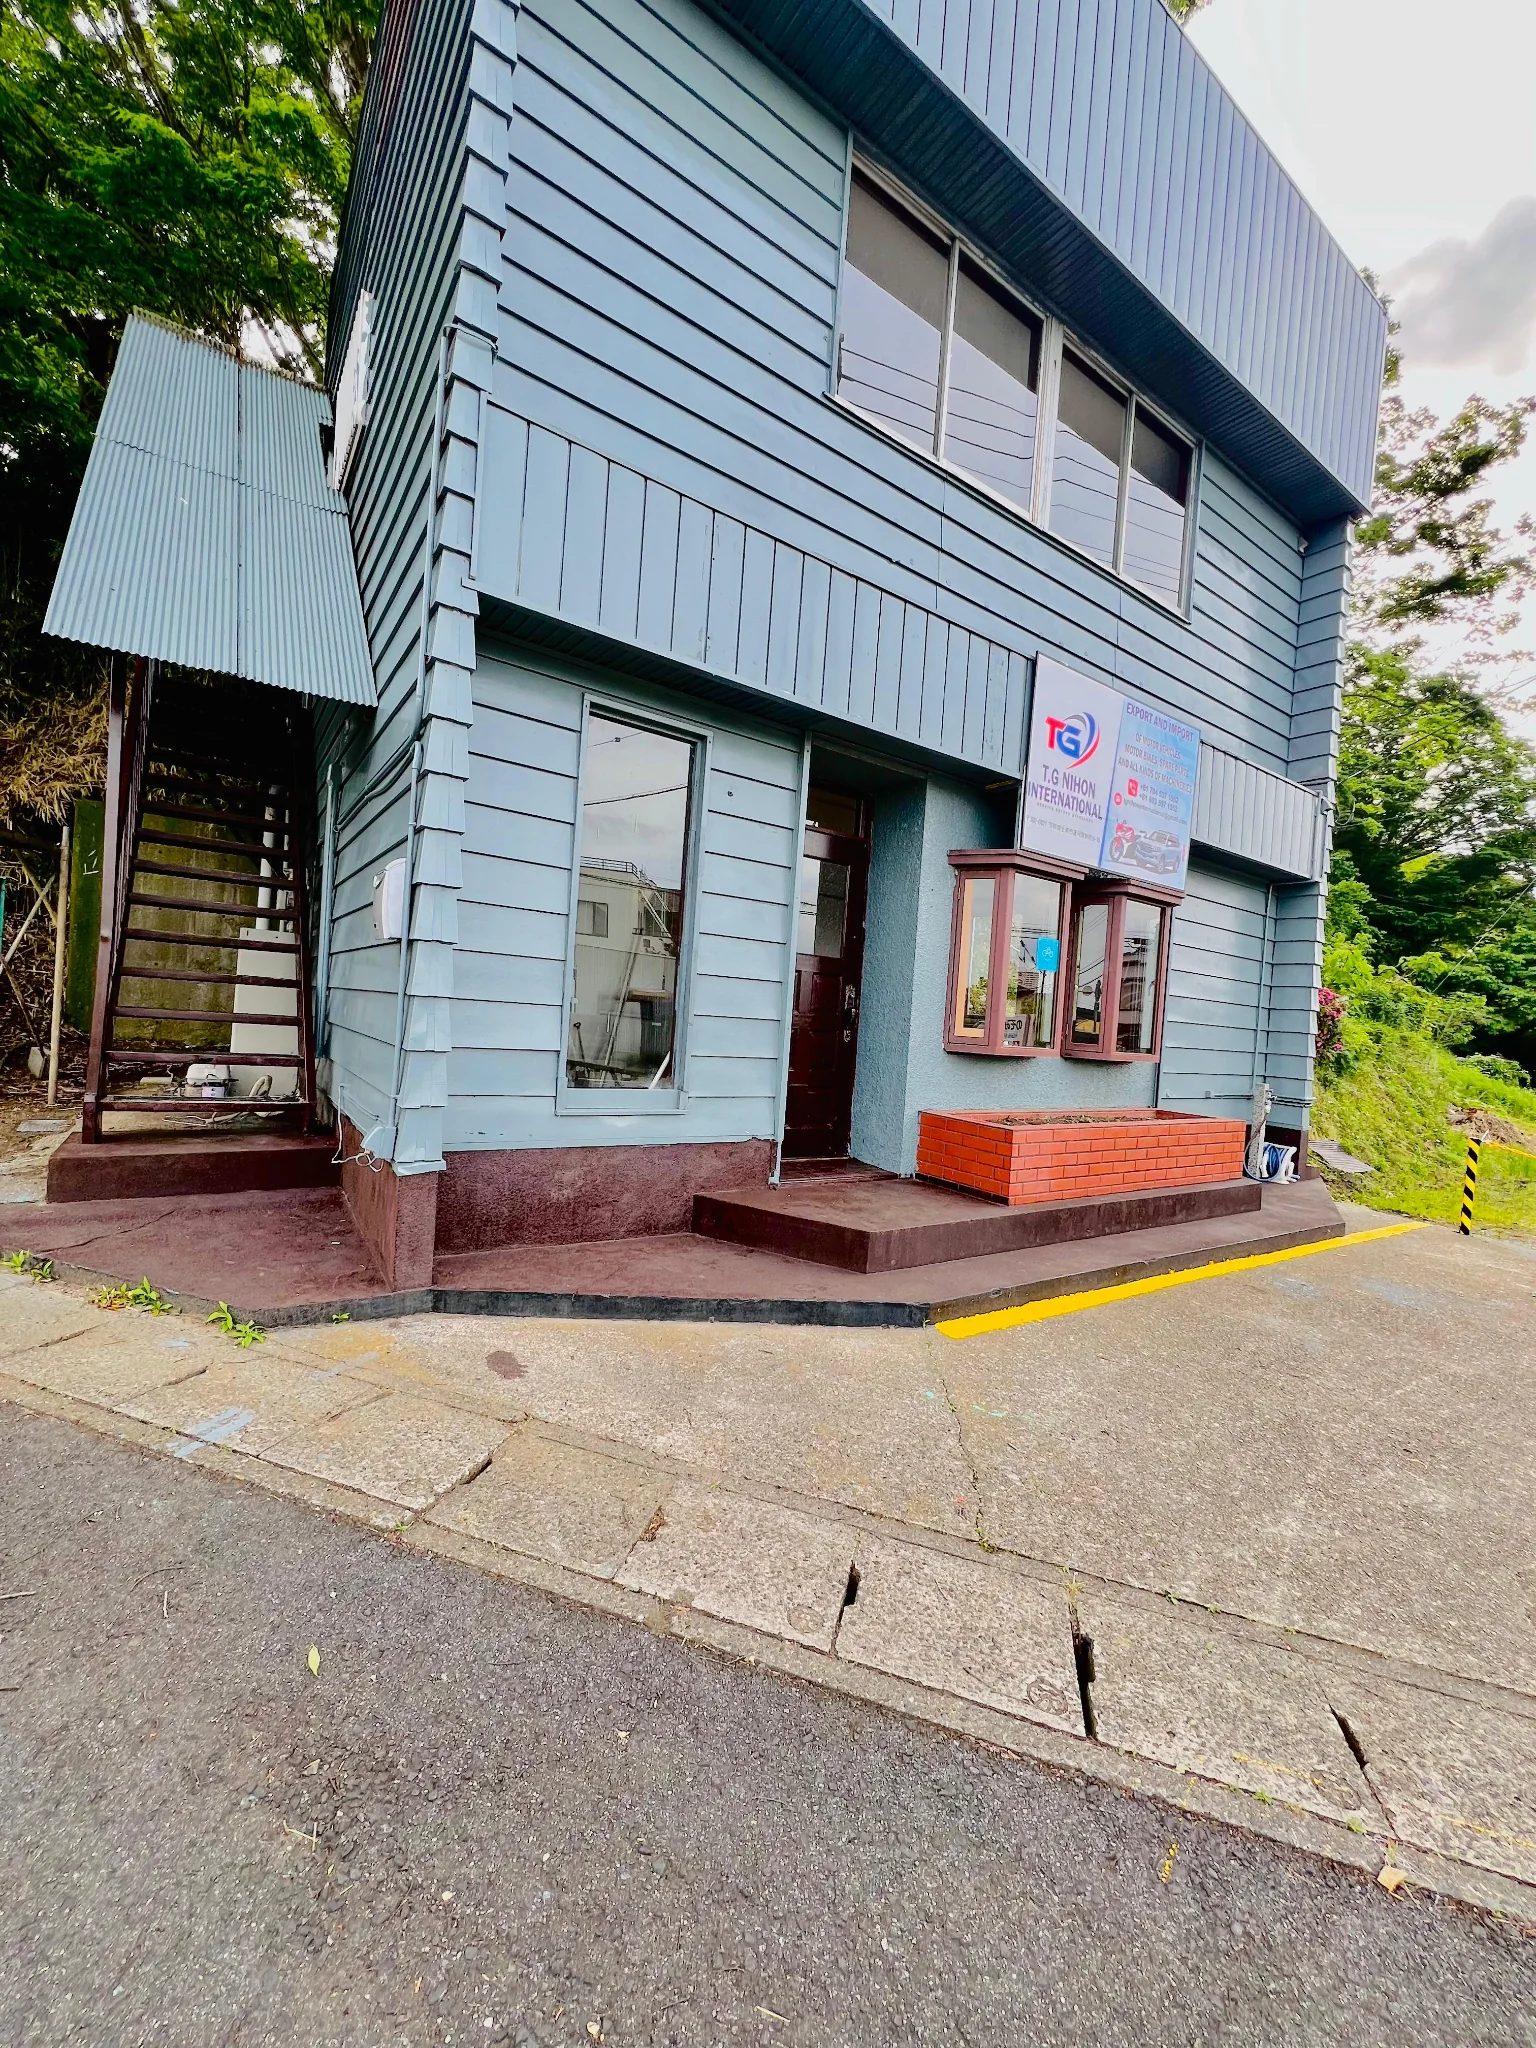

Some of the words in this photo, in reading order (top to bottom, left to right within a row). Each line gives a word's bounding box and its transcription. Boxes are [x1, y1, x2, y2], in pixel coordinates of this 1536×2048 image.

[1126, 702, 1153, 724] EXPORT
[1153, 716, 1168, 730] AND
[1169, 722, 1193, 742] IMPORT
[1125, 744, 1143, 758] MOTOR
[1159, 758, 1175, 772] SPARE
[1175, 765, 1190, 778] PARTS
[1143, 735, 1159, 750] MOTOR
[1160, 743, 1181, 759] VEHICLES
[1043, 764, 1059, 786] T.G
[1062, 772, 1096, 799] NIHON
[1118, 756, 1129, 768] AND
[1129, 760, 1139, 773] ALL
[1139, 764, 1154, 779] KINDS
[1154, 771, 1161, 781] OF
[1161, 773, 1192, 793] MACHINERIES
[1028, 781, 1103, 820] INTERNATIONAL
